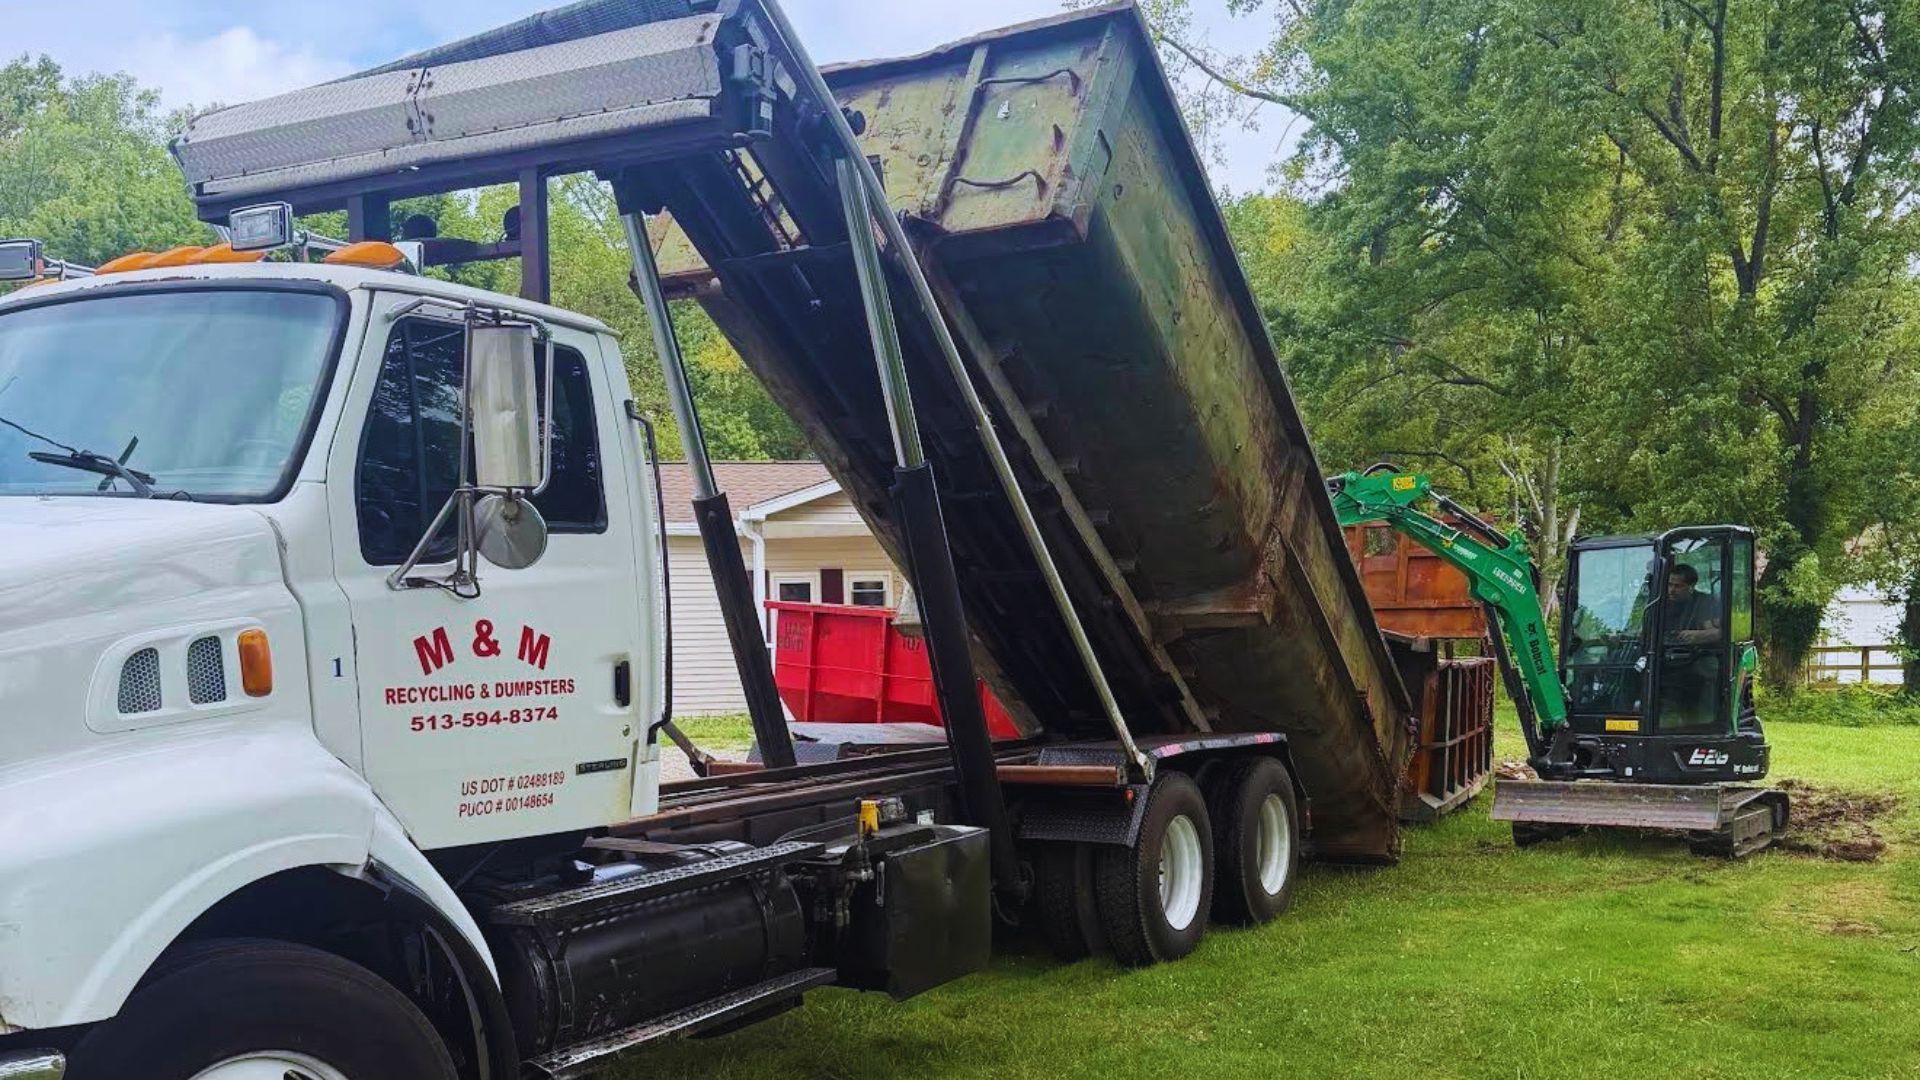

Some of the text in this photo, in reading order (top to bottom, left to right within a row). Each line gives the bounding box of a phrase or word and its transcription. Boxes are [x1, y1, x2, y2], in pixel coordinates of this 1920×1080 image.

[413, 619, 550, 676] M & M
[1529, 637, 1547, 676] Bobcat
[333, 657, 344, 677] 1
[385, 679, 575, 705] RECYCLING & DUMPSTERS
[411, 706, 558, 732] 513-594-8374
[579, 759, 627, 772] STERLING
[461, 771, 565, 796] US DOT # 02488189
[459, 793, 554, 818] PUCO # 00148654
